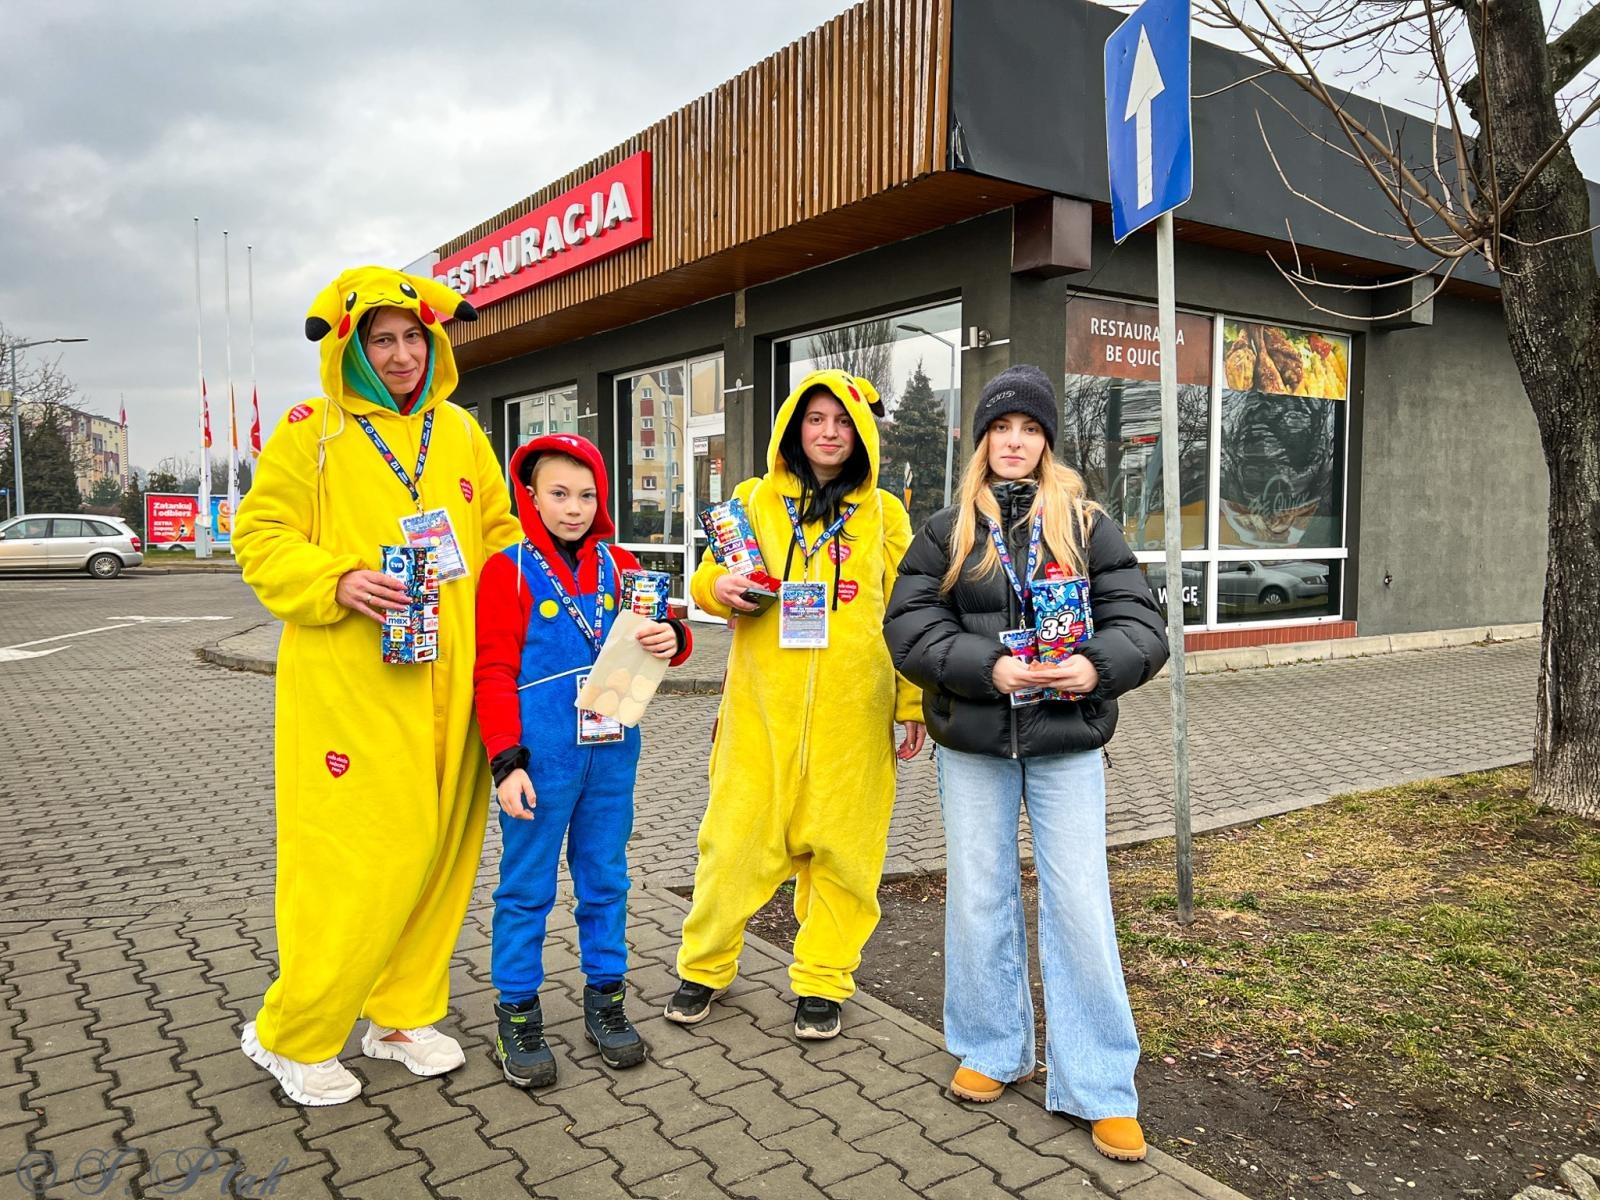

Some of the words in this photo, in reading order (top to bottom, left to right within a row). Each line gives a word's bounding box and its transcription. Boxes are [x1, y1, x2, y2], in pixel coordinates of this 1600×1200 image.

[1090, 317, 1185, 345] RESTAURAA
[1106, 344, 1123, 362] BE
[723, 542, 742, 553] PLAY
[1157, 585, 1198, 606] WGĘ
[1041, 611, 1074, 641] 33
